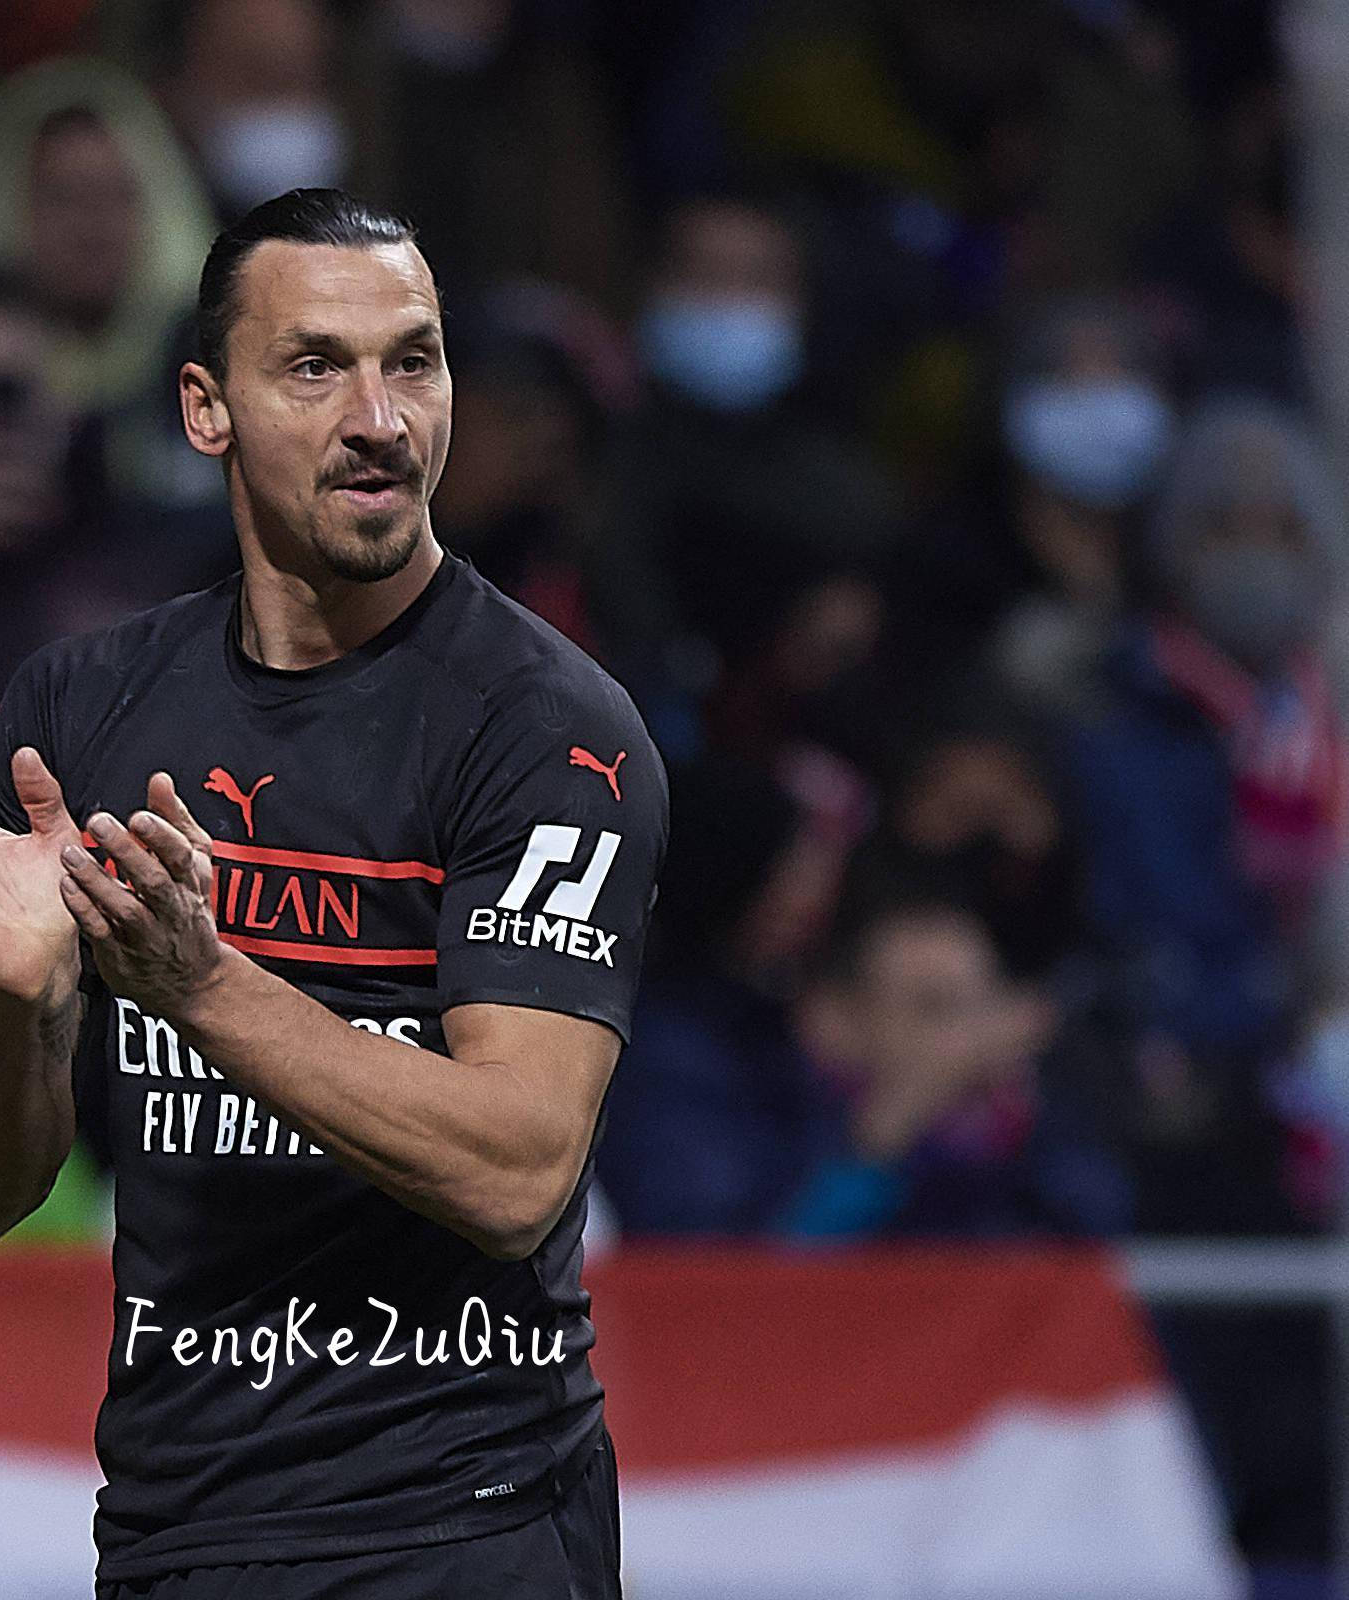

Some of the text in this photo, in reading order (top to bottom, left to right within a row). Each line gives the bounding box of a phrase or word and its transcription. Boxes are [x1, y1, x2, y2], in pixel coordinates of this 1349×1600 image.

[466, 908, 618, 968] BitMEX
[143, 1092, 202, 1153] FLY
[474, 1482, 516, 1499] DRYCELL
